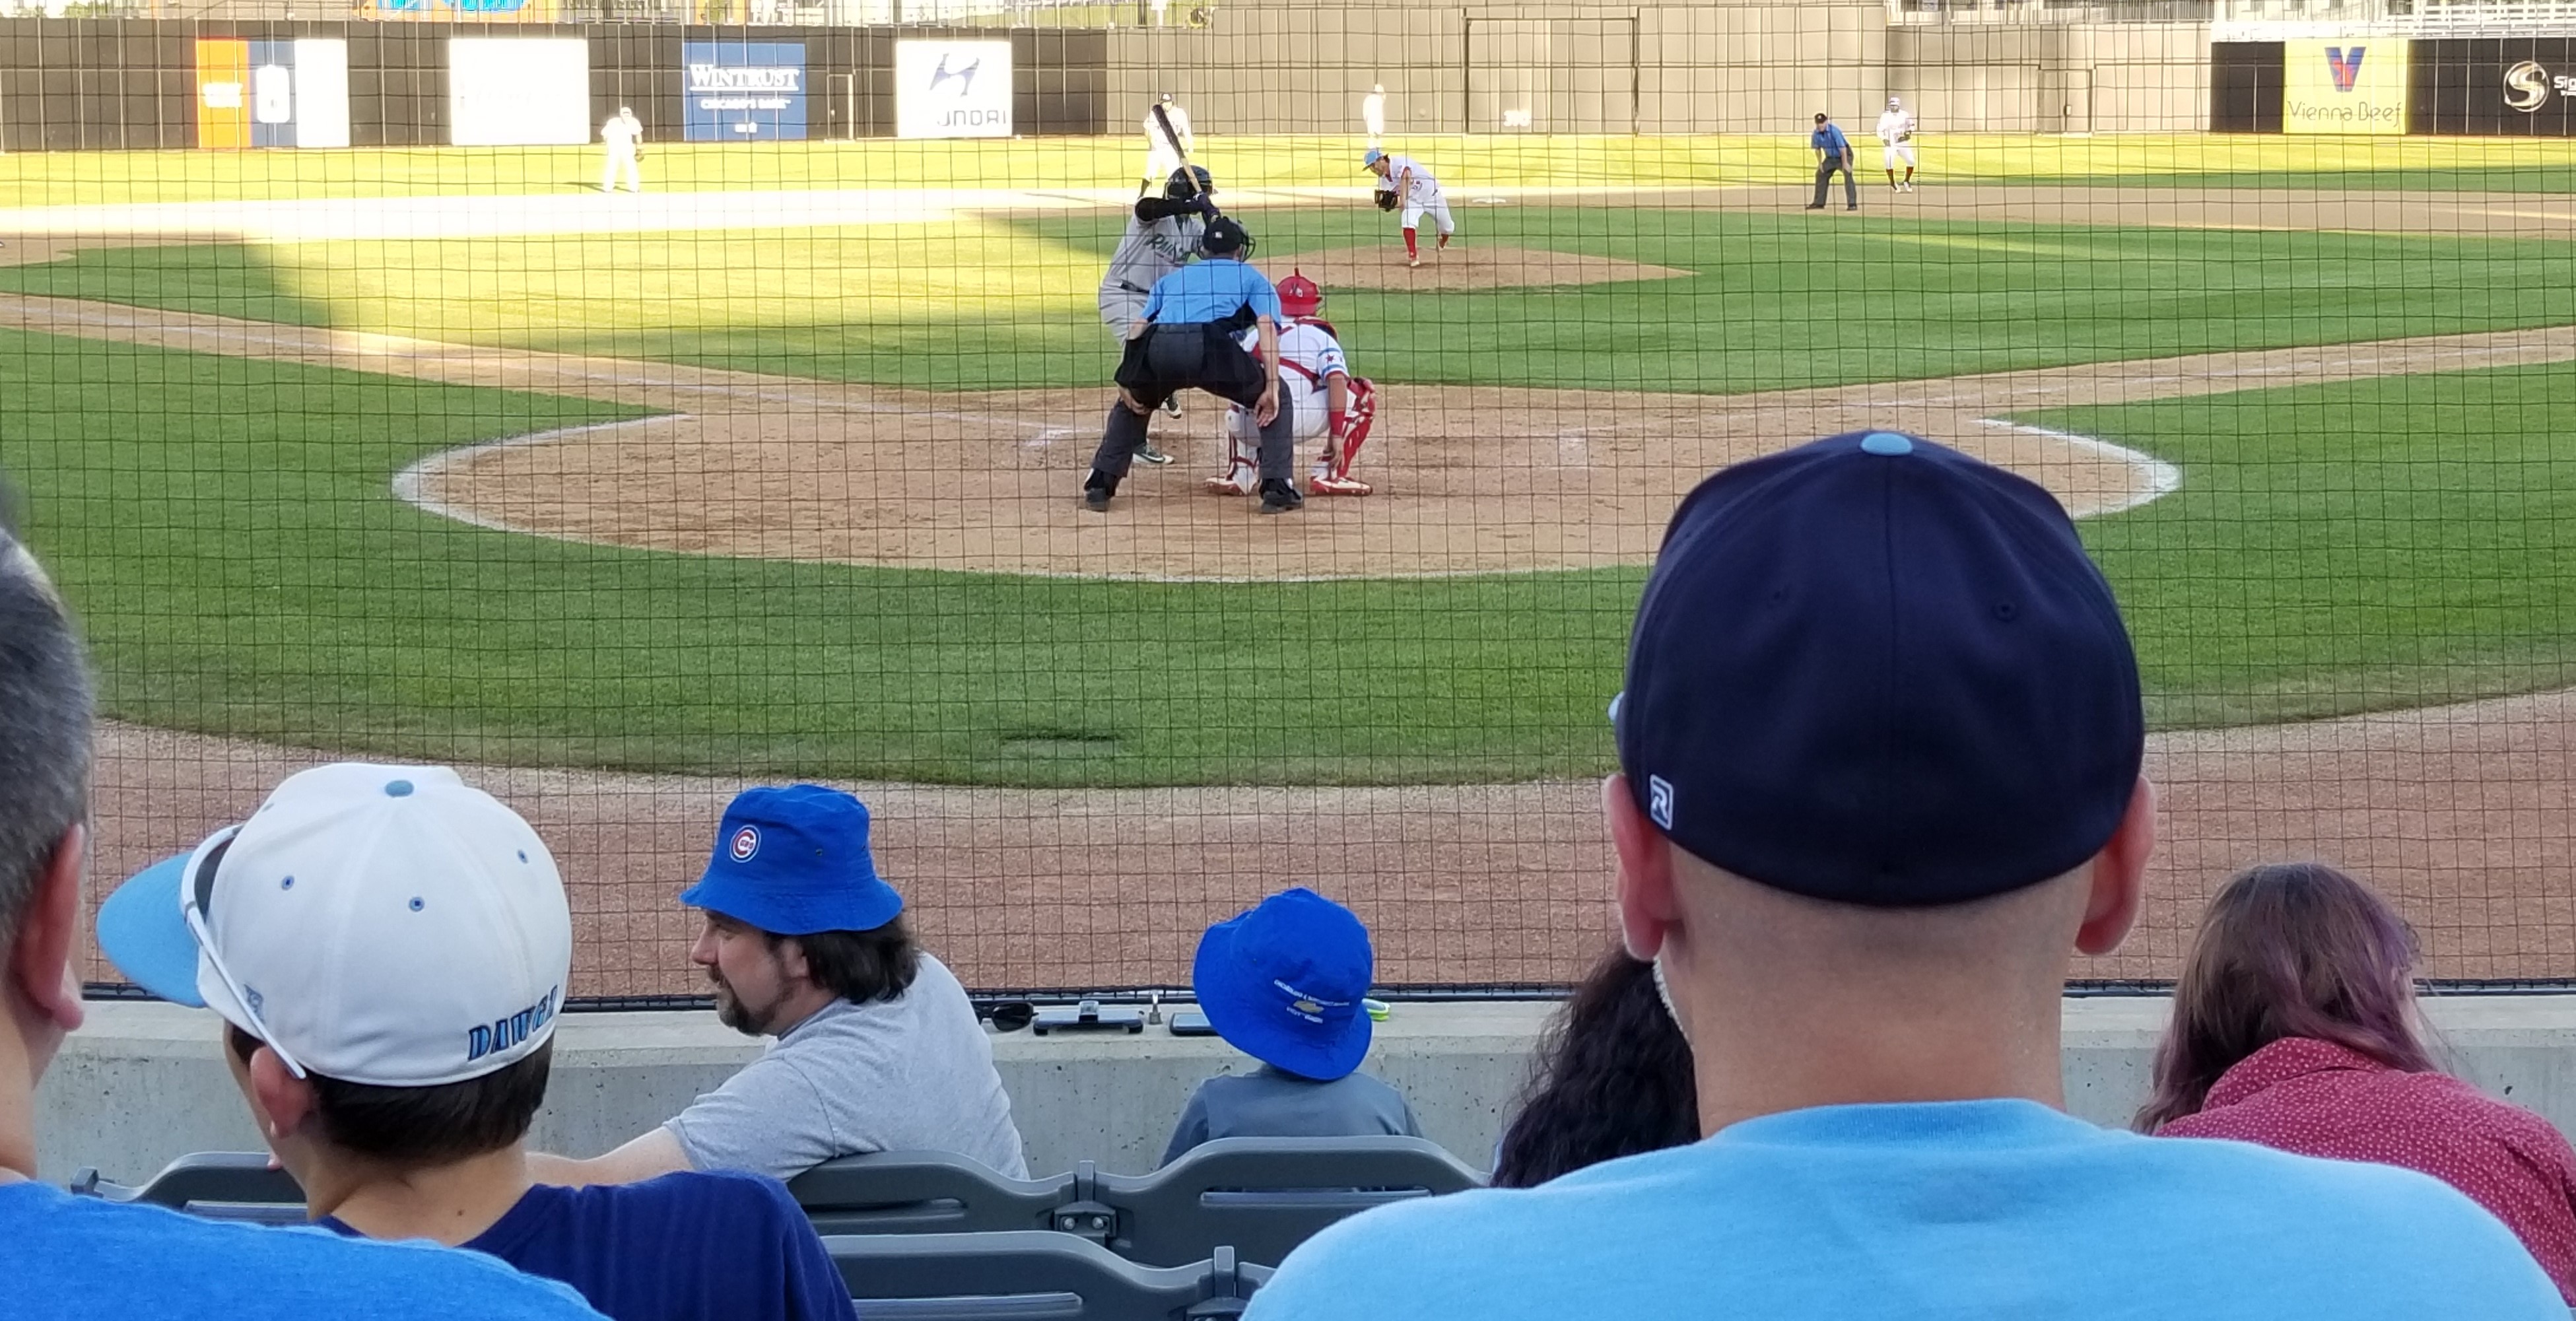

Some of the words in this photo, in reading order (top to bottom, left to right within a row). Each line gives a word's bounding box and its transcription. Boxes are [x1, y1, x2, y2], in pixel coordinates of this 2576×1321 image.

[937, 110, 1006, 126] UNDAI
[2288, 101, 2353, 121] Vienna
[2358, 101, 2402, 127] Beef
